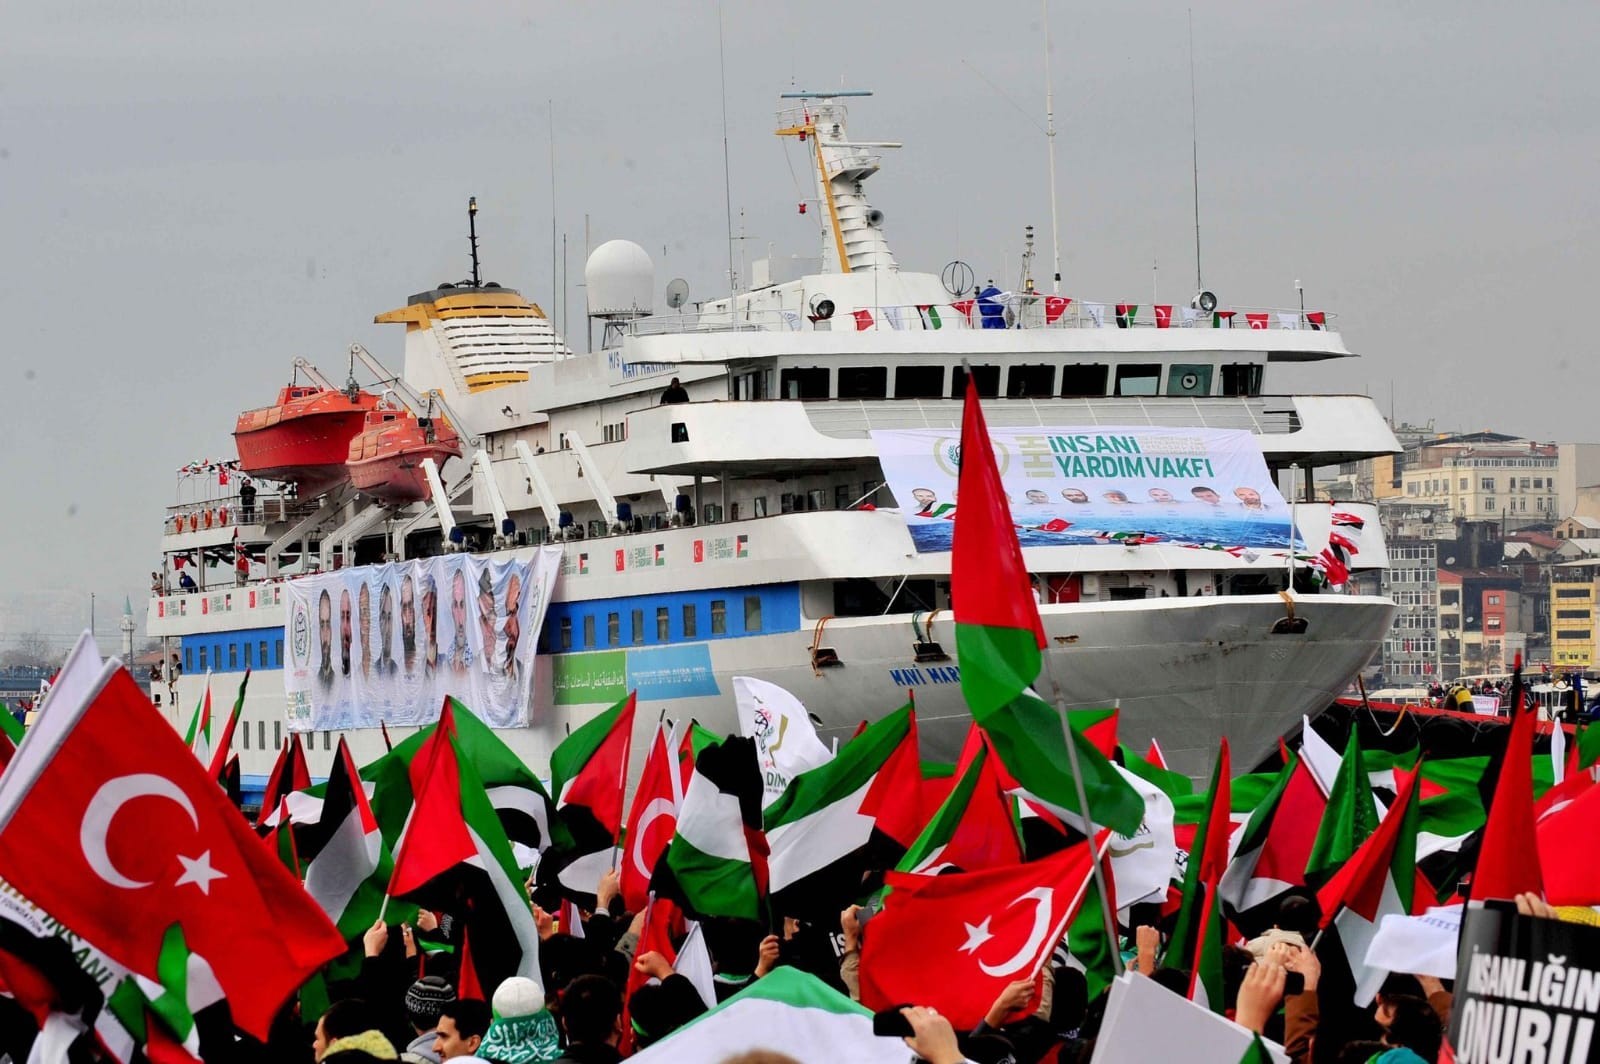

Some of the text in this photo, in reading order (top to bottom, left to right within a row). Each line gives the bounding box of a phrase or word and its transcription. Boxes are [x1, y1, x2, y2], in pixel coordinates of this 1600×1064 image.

[1055, 455, 1215, 479] YARDIM VAKFI
[925, 666, 961, 684] MAR
